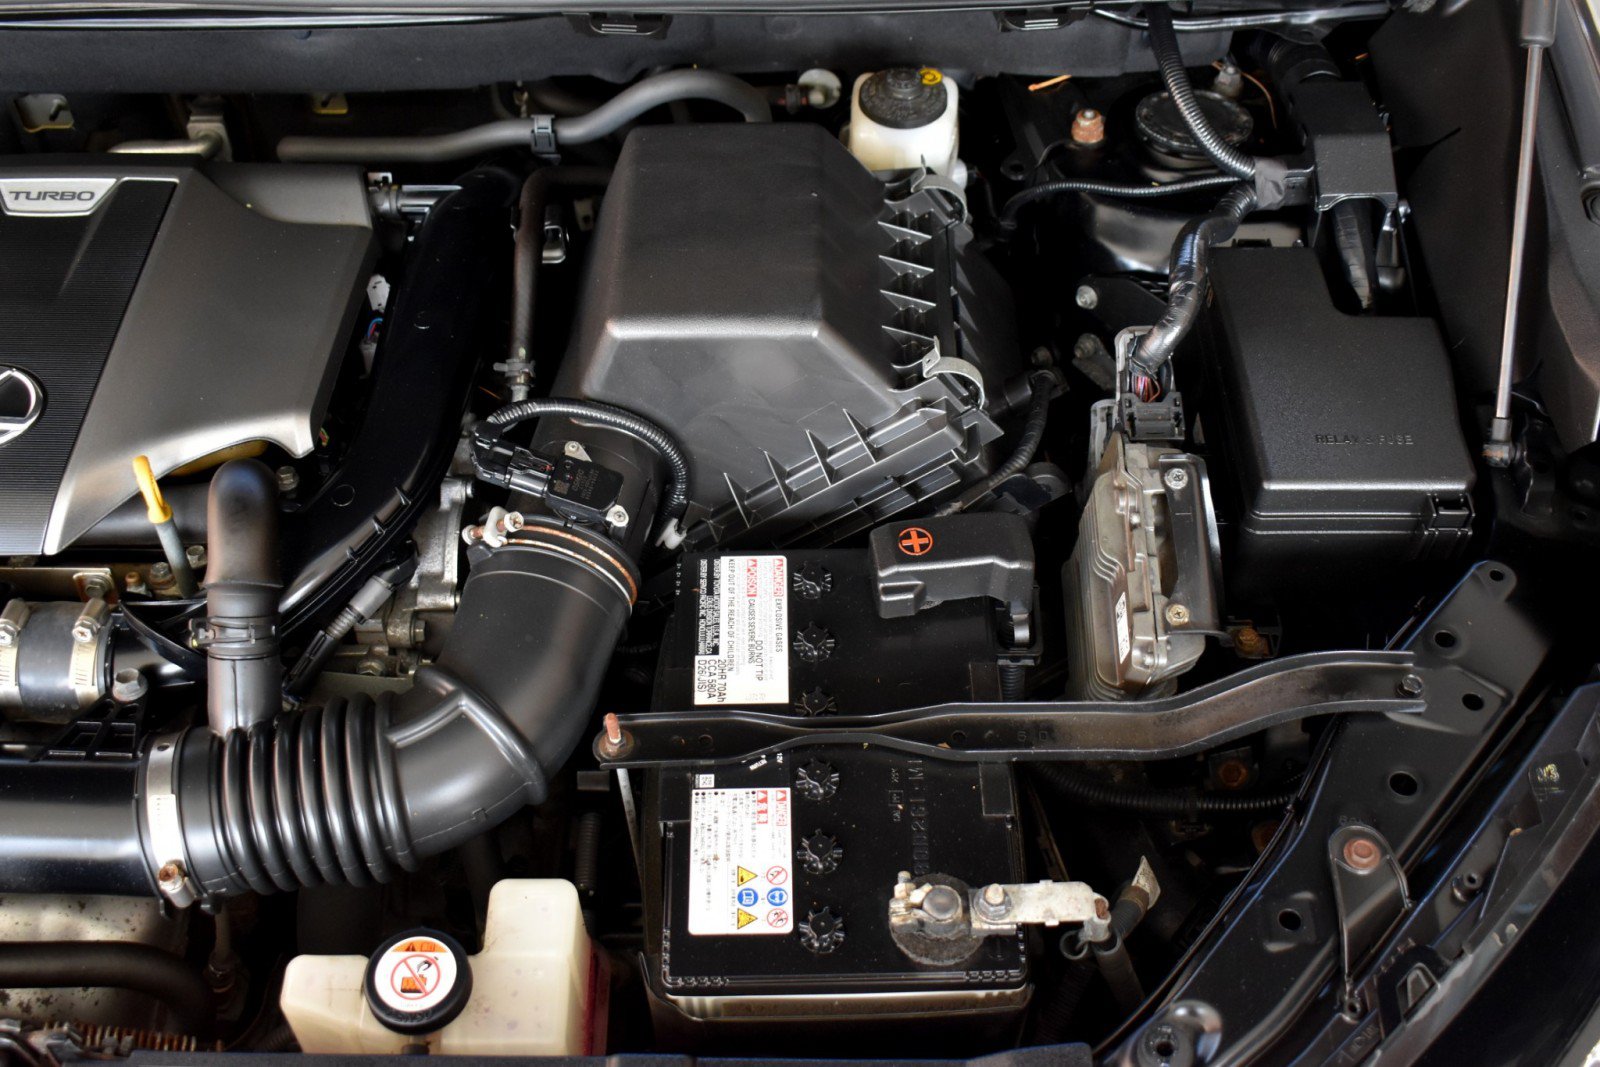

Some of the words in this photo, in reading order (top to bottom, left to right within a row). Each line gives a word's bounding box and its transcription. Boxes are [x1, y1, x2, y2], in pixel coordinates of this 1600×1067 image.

[9, 191, 95, 201] TURBO
[1315, 434, 1359, 445] RELAY
[1378, 434, 1414, 445] FUSE
[747, 567, 756, 594] POISON
[774, 567, 783, 595] DANGER
[755, 640, 763, 650] DO
[708, 659, 716, 677] CCA
[718, 659, 726, 680] 20HR
[755, 653, 763, 667] NOT
[697, 660, 706, 692] D26(JIS)
[707, 679, 716, 698] 580A
[717, 682, 726, 702] 70Ah
